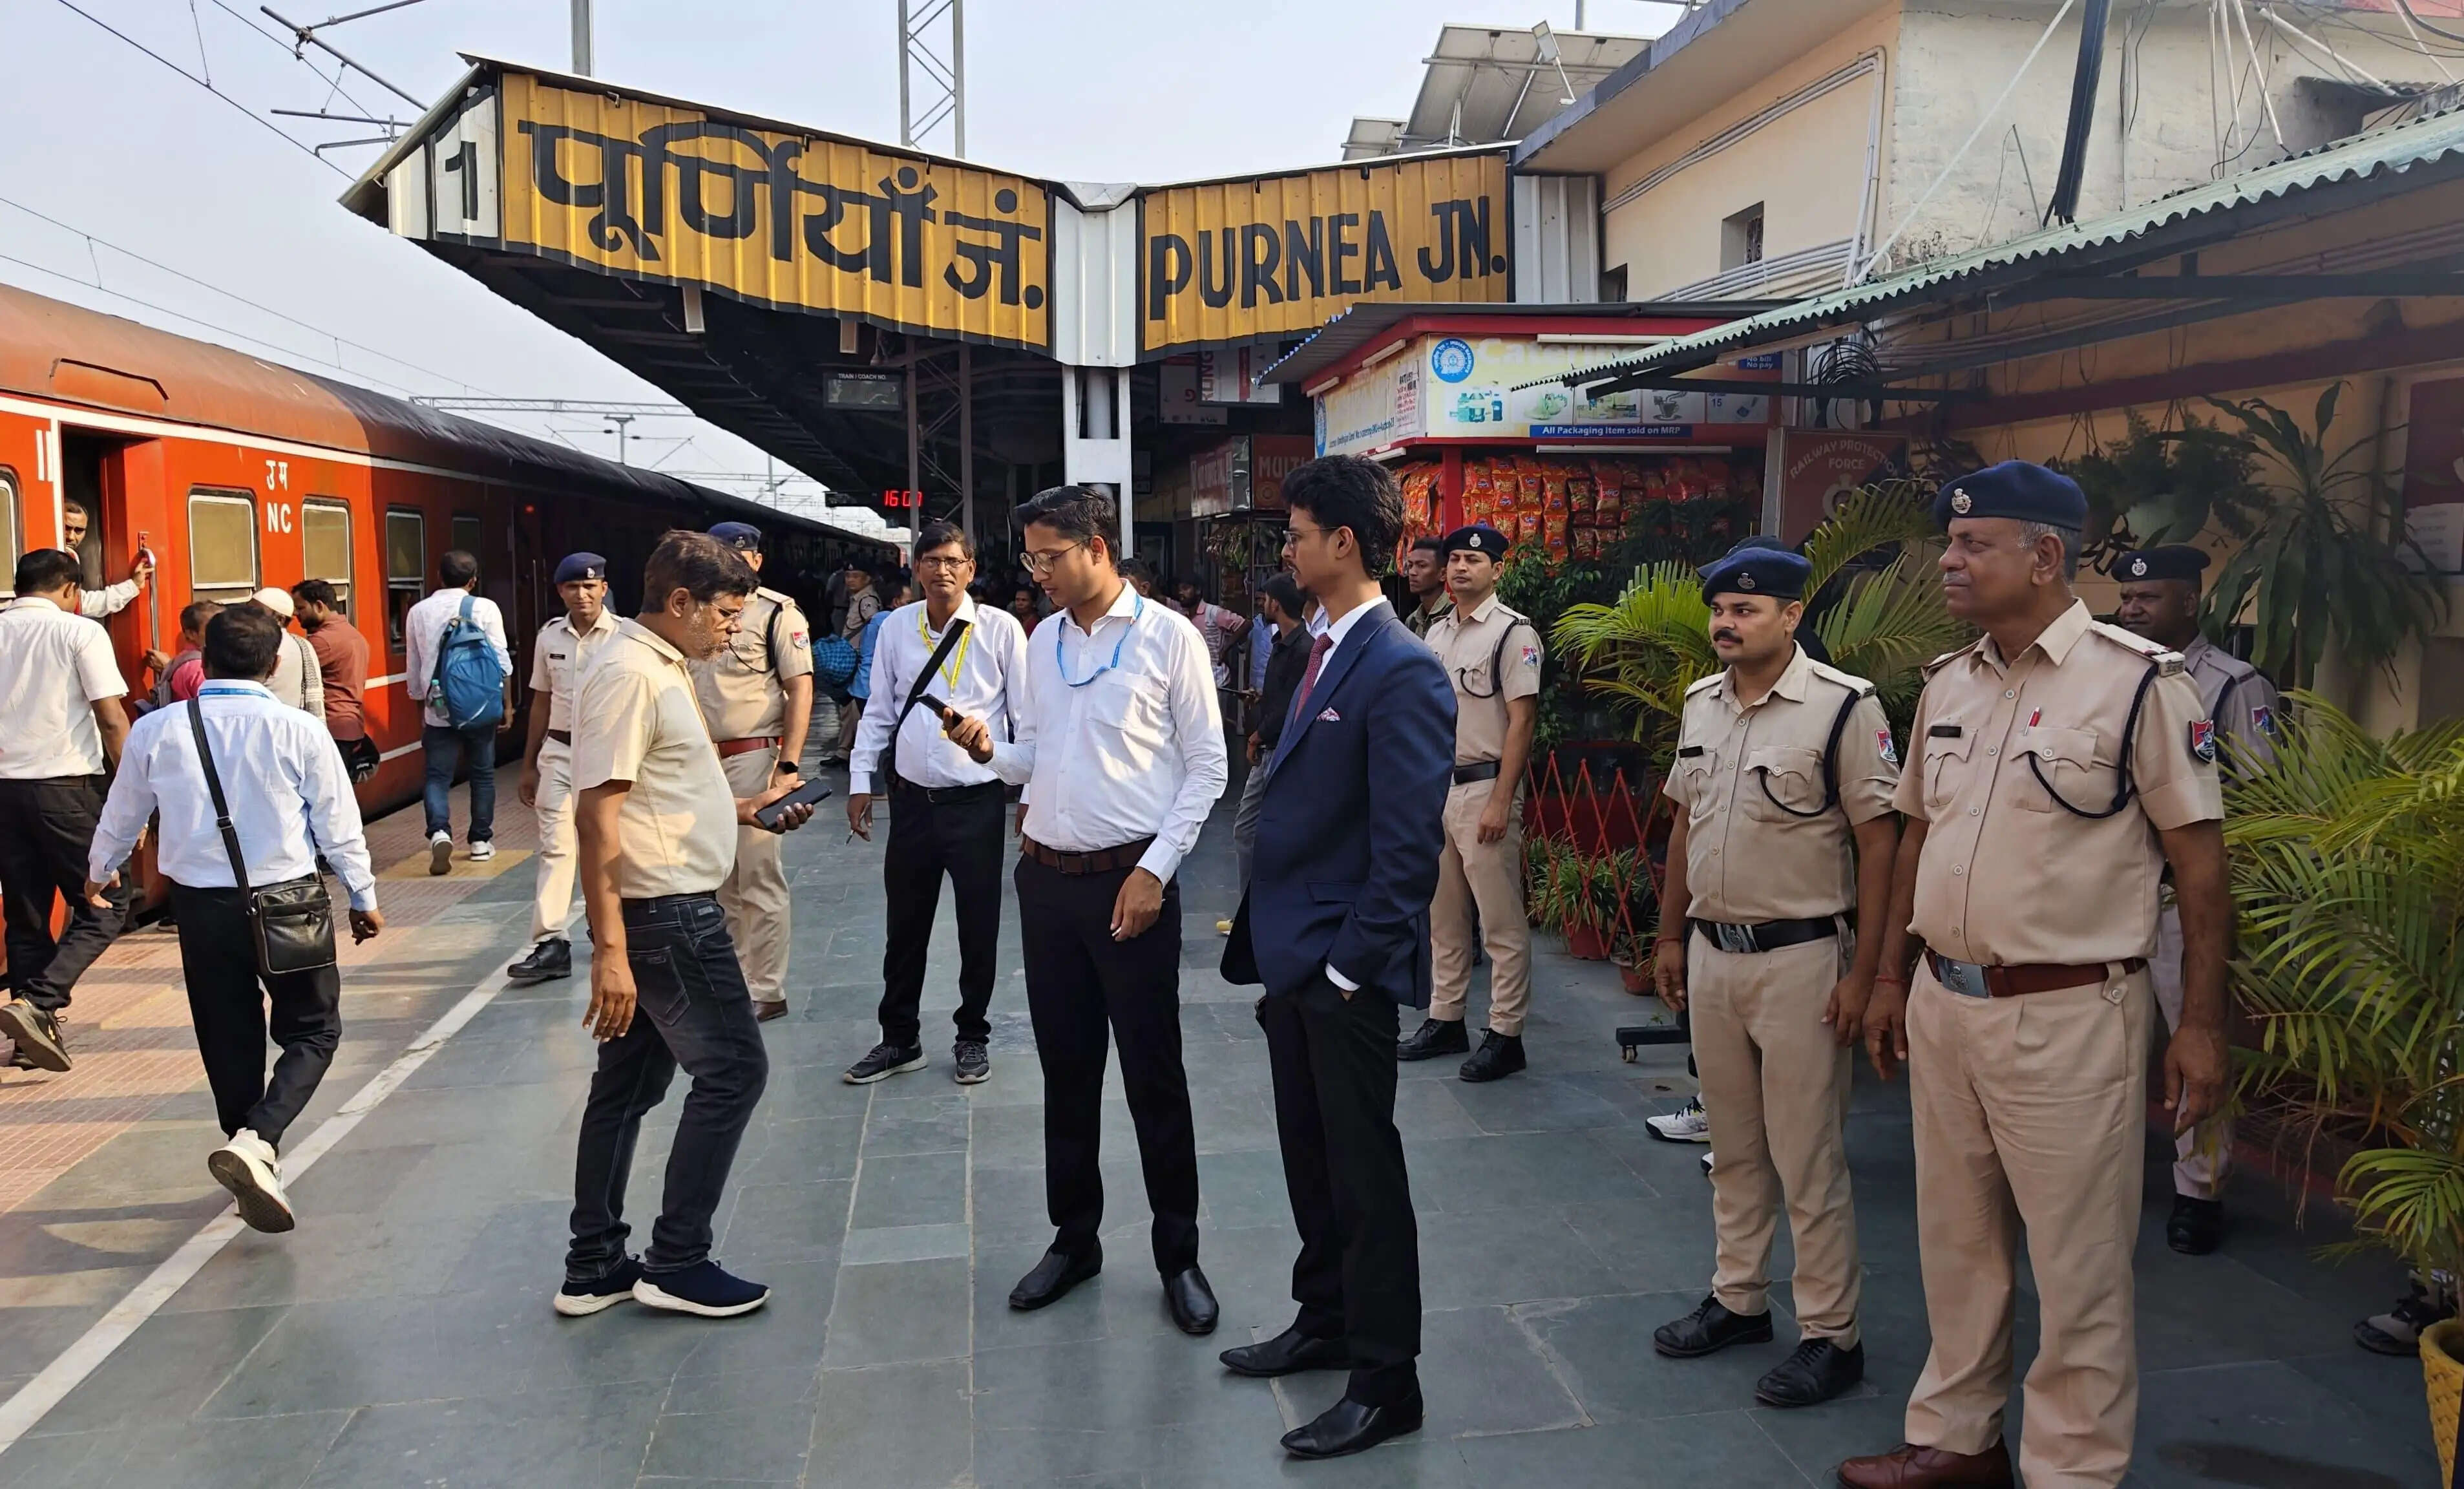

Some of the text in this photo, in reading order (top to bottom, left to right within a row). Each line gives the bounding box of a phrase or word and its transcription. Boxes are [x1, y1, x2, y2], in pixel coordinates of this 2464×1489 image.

[1149, 195, 1506, 321] PURNEA JN.
[1712, 398, 1722, 407] 15
[1557, 427, 1604, 436] Packaging
[1790, 439, 1838, 479] RAILWAY
[1829, 458, 1866, 470] FORCE
[267, 502, 292, 534] NC
